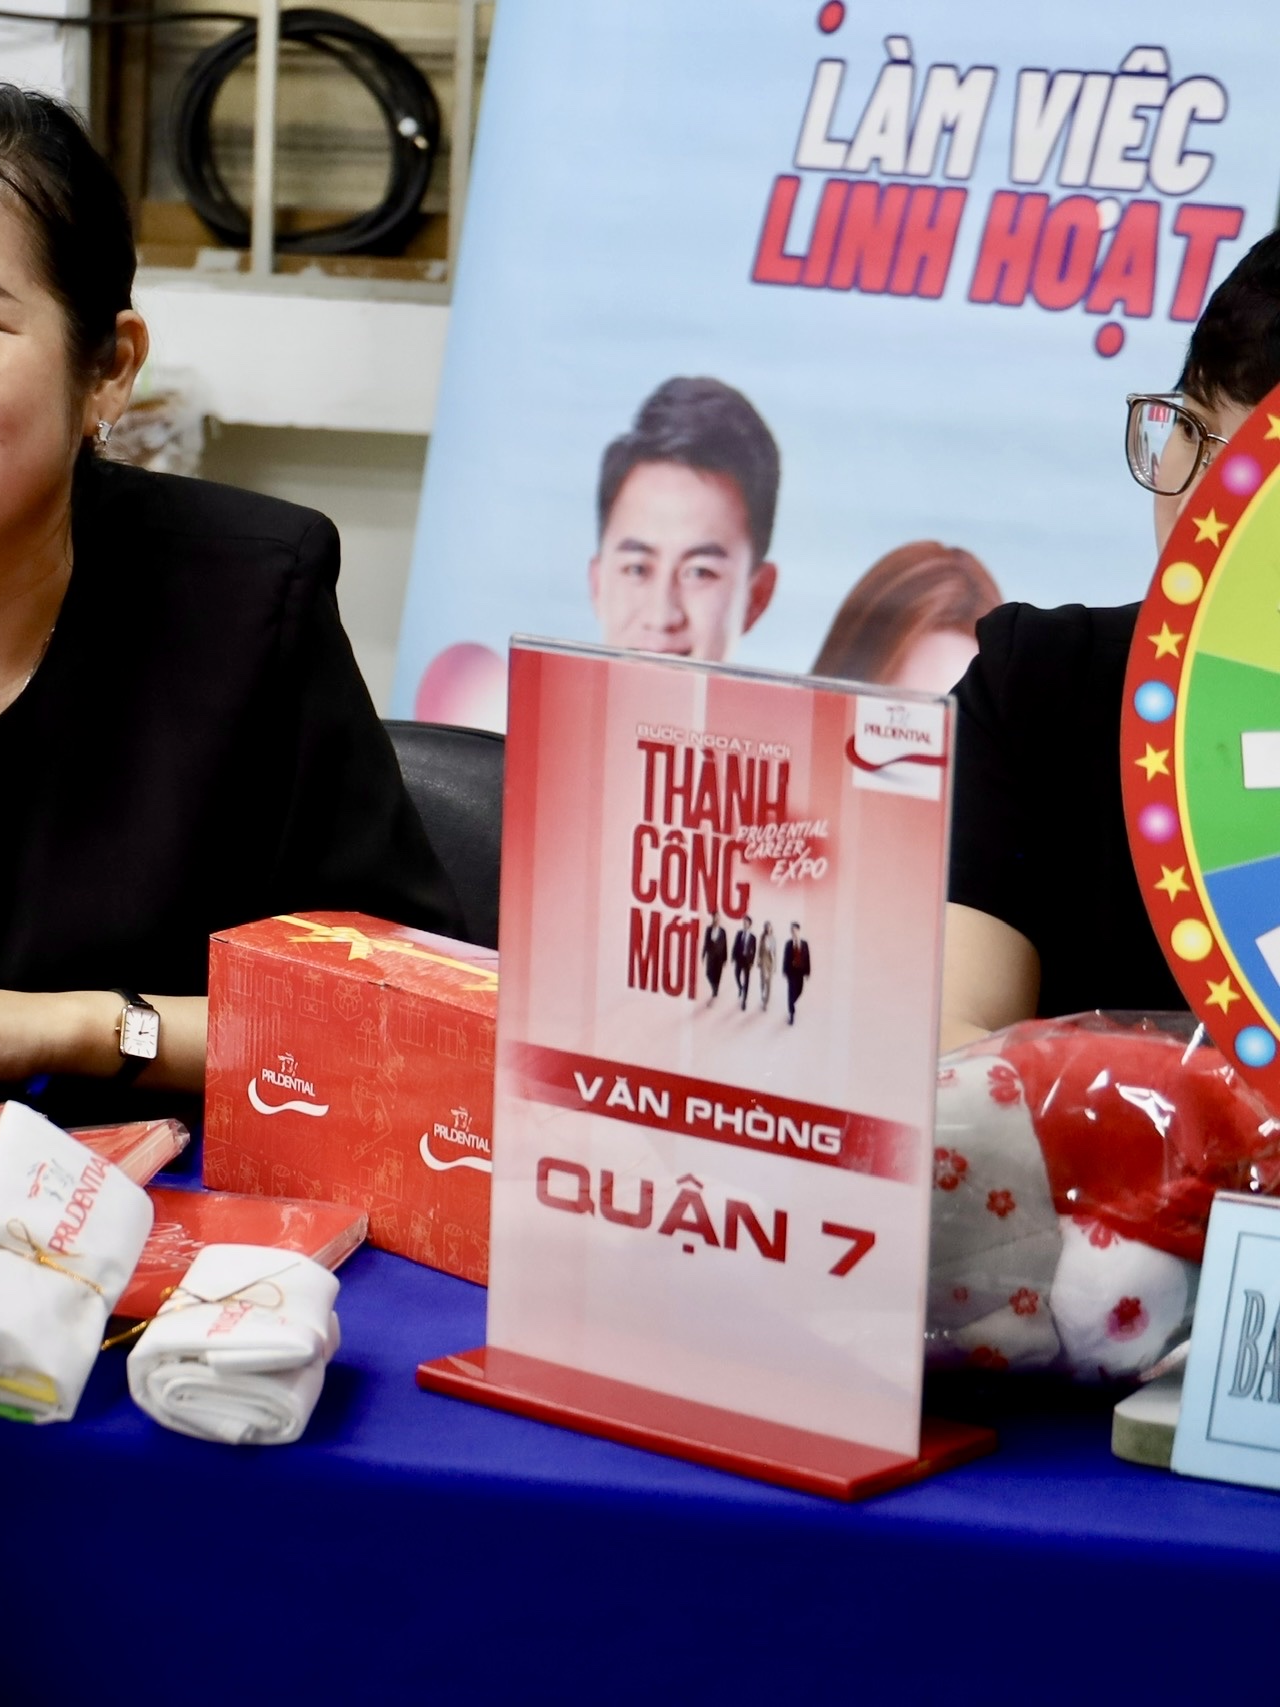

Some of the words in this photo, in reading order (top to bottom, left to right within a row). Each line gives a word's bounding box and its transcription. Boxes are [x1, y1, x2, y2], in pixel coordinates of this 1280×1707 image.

[794, 35, 998, 181] LÀM
[750, 175, 968, 299] LINH
[863, 722, 932, 746] PRUDENTIAL
[637, 740, 791, 835] THÀNH
[735, 820, 829, 843] PRUDENTIAL
[631, 823, 752, 920] CÔNG
[744, 840, 806, 861] CAREER
[769, 847, 829, 889] EXPO
[627, 907, 700, 1001] MỚI
[261, 1068, 316, 1098] PRUDENTIAL
[573, 1071, 671, 1120] VĂN
[684, 1096, 843, 1156] PHÒNG
[433, 1122, 491, 1153] PRUDENTIAL
[47, 1155, 112, 1256] PRUDENTIA
[535, 1156, 788, 1264] QUẬN
[821, 1220, 876, 1278] 7
